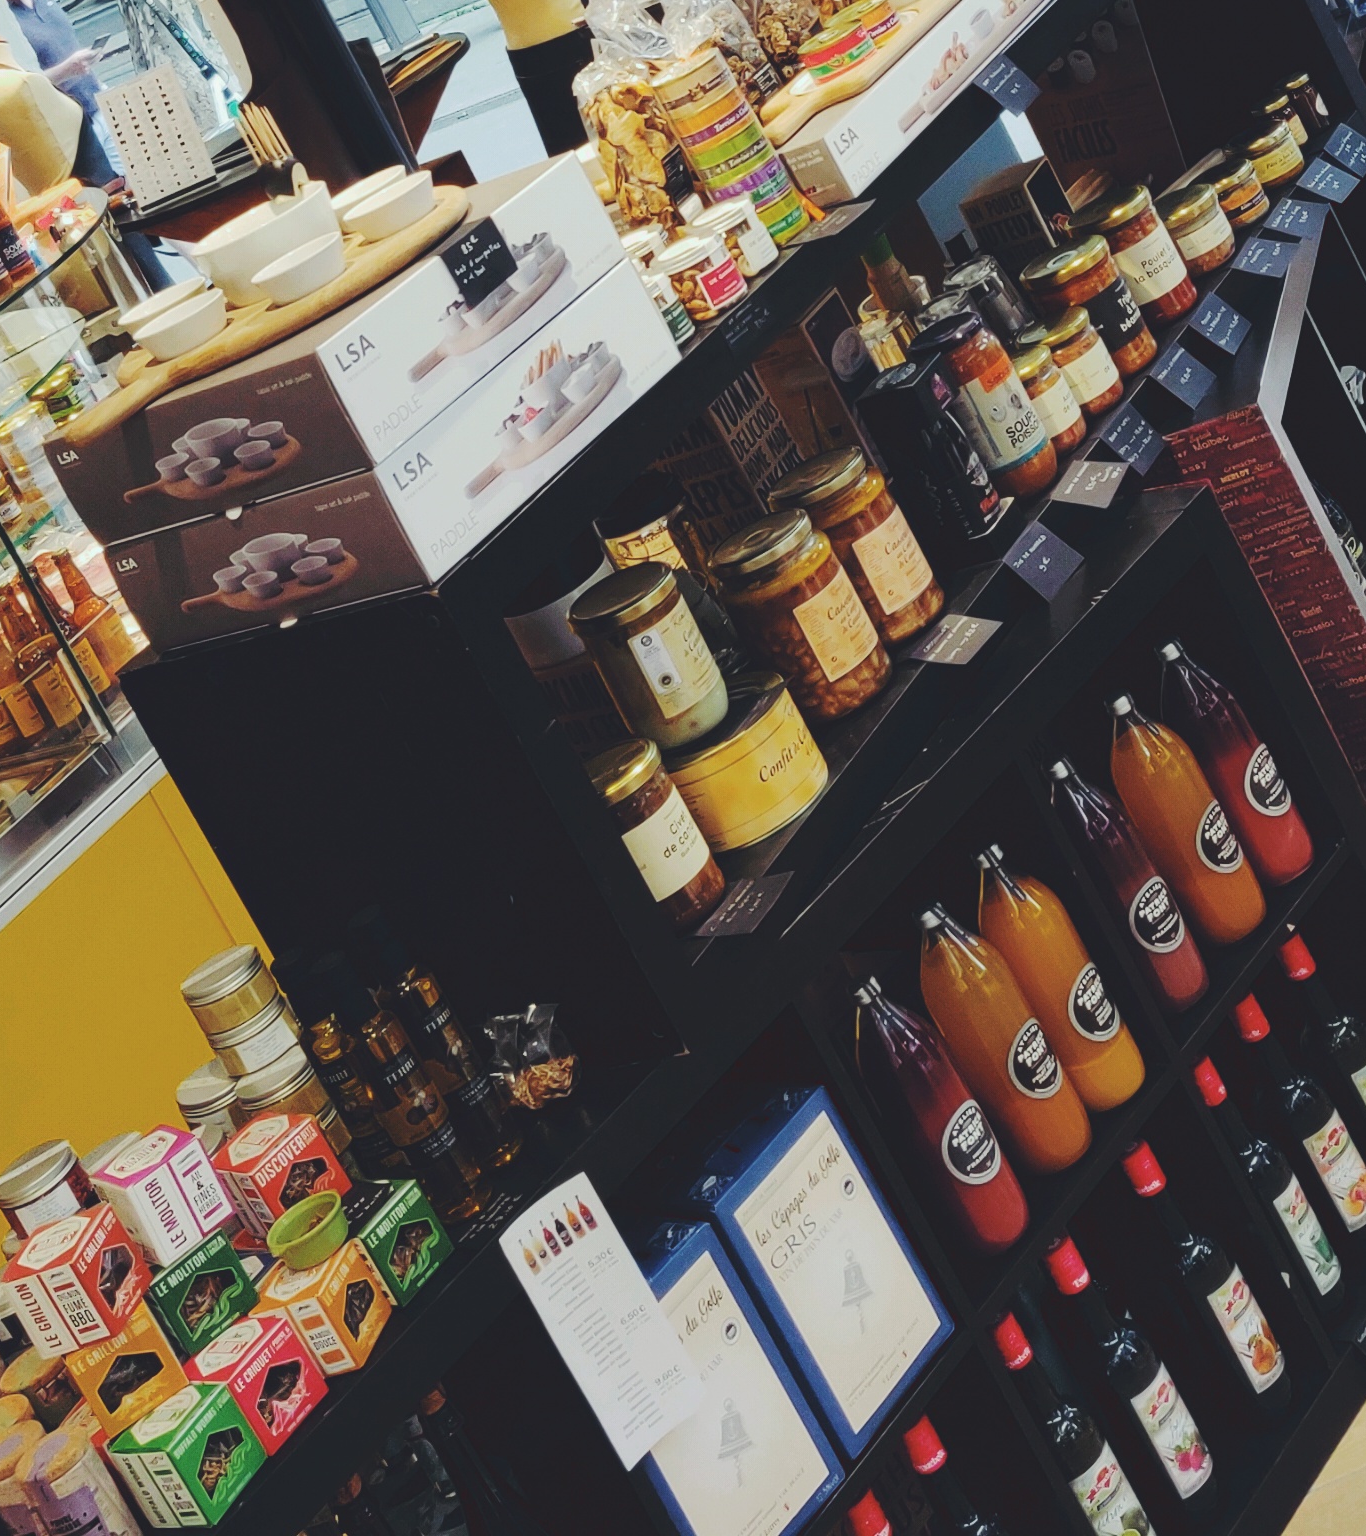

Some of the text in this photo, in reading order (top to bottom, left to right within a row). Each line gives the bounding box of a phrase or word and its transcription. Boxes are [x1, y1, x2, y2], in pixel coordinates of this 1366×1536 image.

[833, 127, 859, 156] LSA
[1140, 248, 1166, 269] Poulet
[1133, 272, 1146, 285] la
[335, 333, 376, 372] LSA
[372, 393, 423, 441] PADDLE
[730, 396, 779, 462] DELICIOUS
[56, 449, 80, 466] LSA
[393, 451, 434, 491] LSA
[430, 509, 480, 560] PADDLE
[115, 556, 138, 573] LSA
[759, 747, 793, 783] Confit
[663, 842, 678, 859] de
[1147, 895, 1170, 924] FONT
[1085, 982, 1105, 1011] FONT
[1026, 1039, 1048, 1068] FONT
[961, 1122, 986, 1152] FONT
[254, 1135, 306, 1188] DISCOVER
[193, 1183, 217, 1205] FINES
[196, 1182, 204, 1191] &
[755, 1143, 841, 1248] les Cépages du Golfe
[144, 1176, 188, 1250] LE MOLITOR
[367, 1200, 407, 1249] LE MOLITOR
[770, 1214, 818, 1270] GRIS
[76, 1259, 86, 1275] LE
[155, 1251, 207, 1298] LE MOLITOR
[15, 1282, 63, 1349] LE GRILLON
[69, 1310, 96, 1328] BBQ
[685, 1288, 724, 1337] du Golfe
[71, 1331, 130, 1376] LE GRILLON
[234, 1347, 273, 1393] LE CRIQUET
